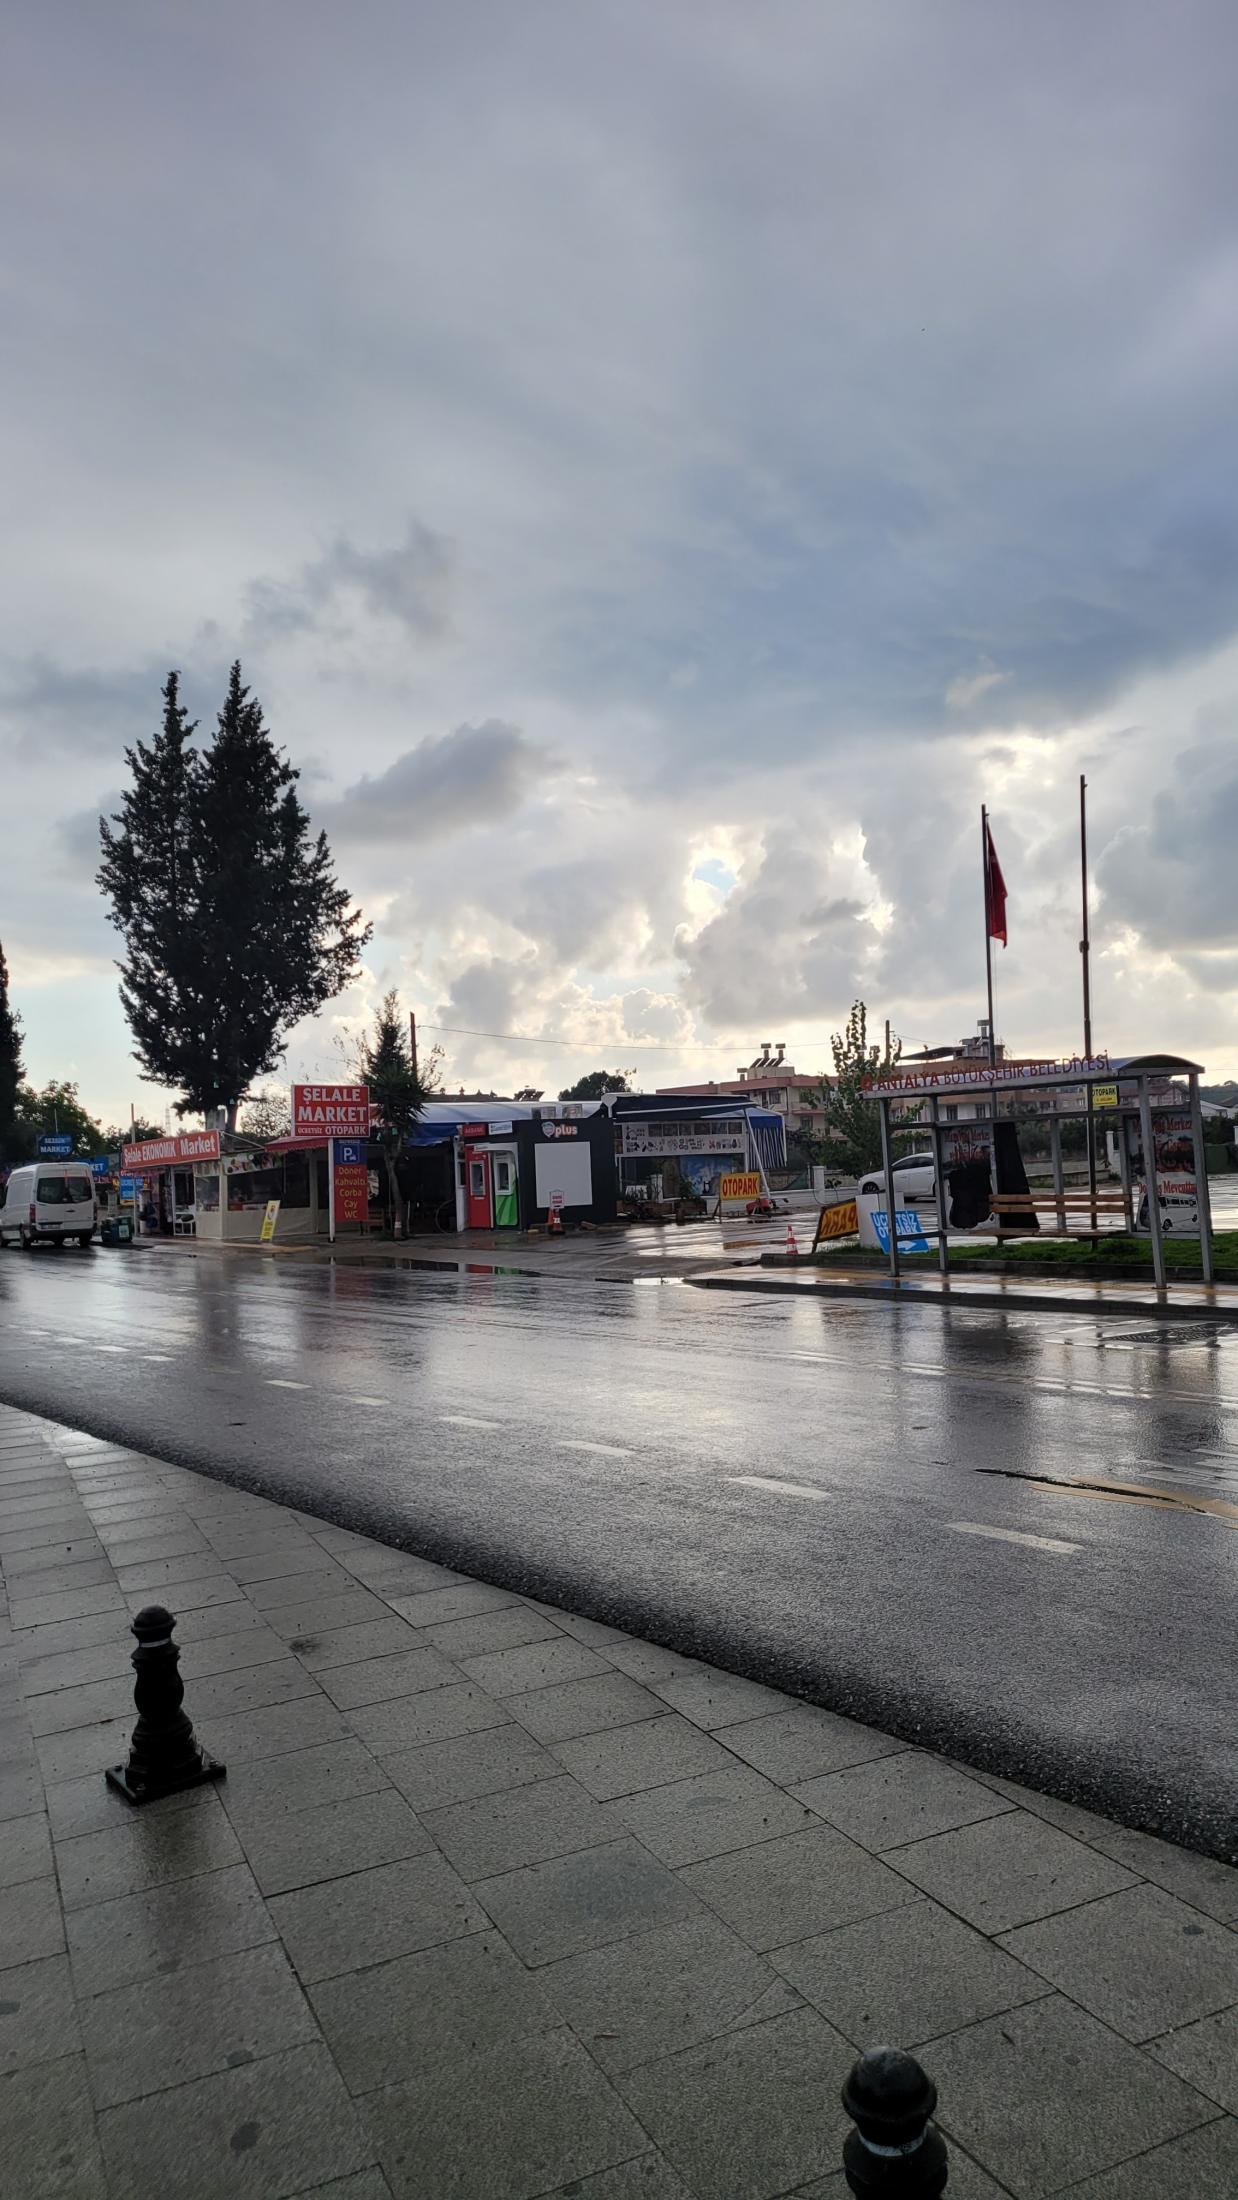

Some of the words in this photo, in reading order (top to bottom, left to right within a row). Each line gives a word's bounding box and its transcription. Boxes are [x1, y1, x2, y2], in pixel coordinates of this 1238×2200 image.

[877, 1071, 940, 1090] ANTALYA
[1029, 1049, 1110, 1077] BELEDİYESİ
[303, 1088, 361, 1105] ŞELALE
[298, 1106, 367, 1122] MARKET
[325, 1126, 366, 1135] OTOPARK
[555, 1124, 578, 1138] plus
[40, 1145, 71, 1153] MARKET
[180, 1135, 216, 1156] Market
[722, 1177, 758, 1197] OTOPARK
[344, 1210, 358, 1219] WC
